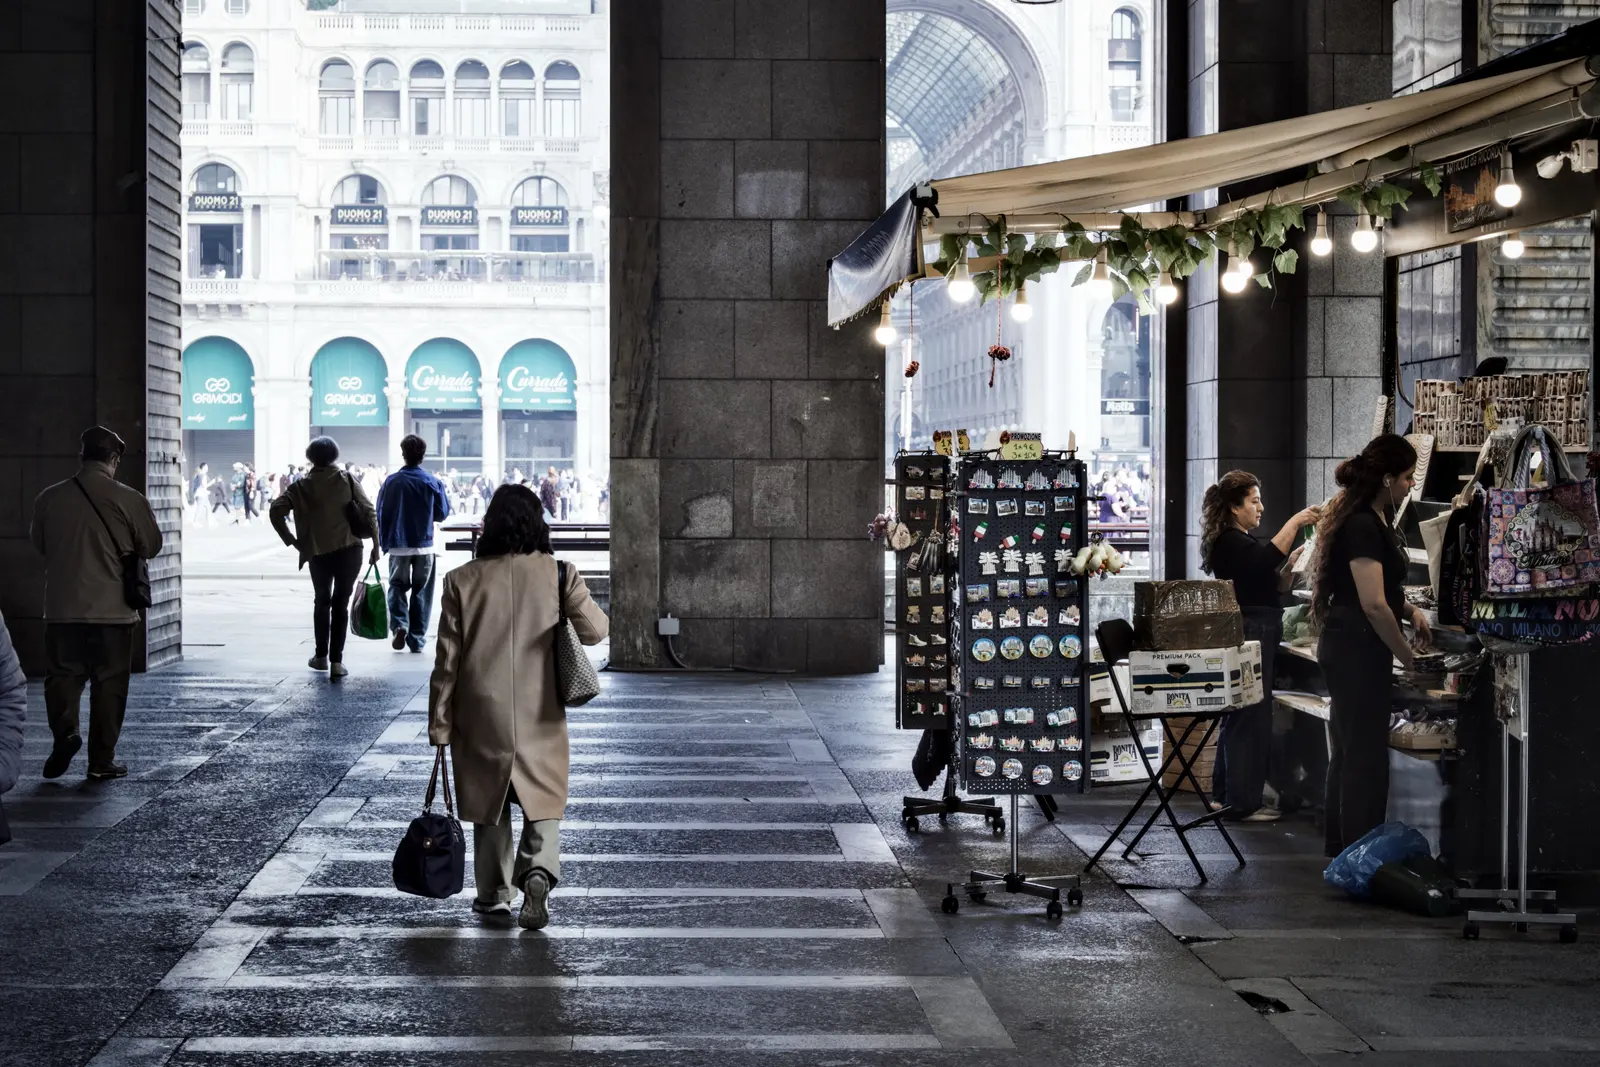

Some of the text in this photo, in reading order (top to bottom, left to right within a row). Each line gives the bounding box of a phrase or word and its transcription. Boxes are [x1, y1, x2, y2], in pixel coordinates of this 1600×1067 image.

[195, 195, 239, 205] DUOMO 21
[337, 209, 382, 219] DUOMO 21
[427, 209, 473, 219] DUOMO 21
[518, 209, 563, 219] DUOMO 21
[412, 365, 474, 392] Currado
[506, 366, 568, 392] Currado
[192, 392, 243, 405] GRIMOLDI
[324, 393, 376, 406] GRIMOLDI
[1010, 432, 1042, 441] PROMOZIONE
[1470, 599, 1600, 620] MILANO
[1512, 622, 1561, 637] MILANO
[1166, 692, 1191, 705] BONITA
[1113, 743, 1138, 762] BONITA
